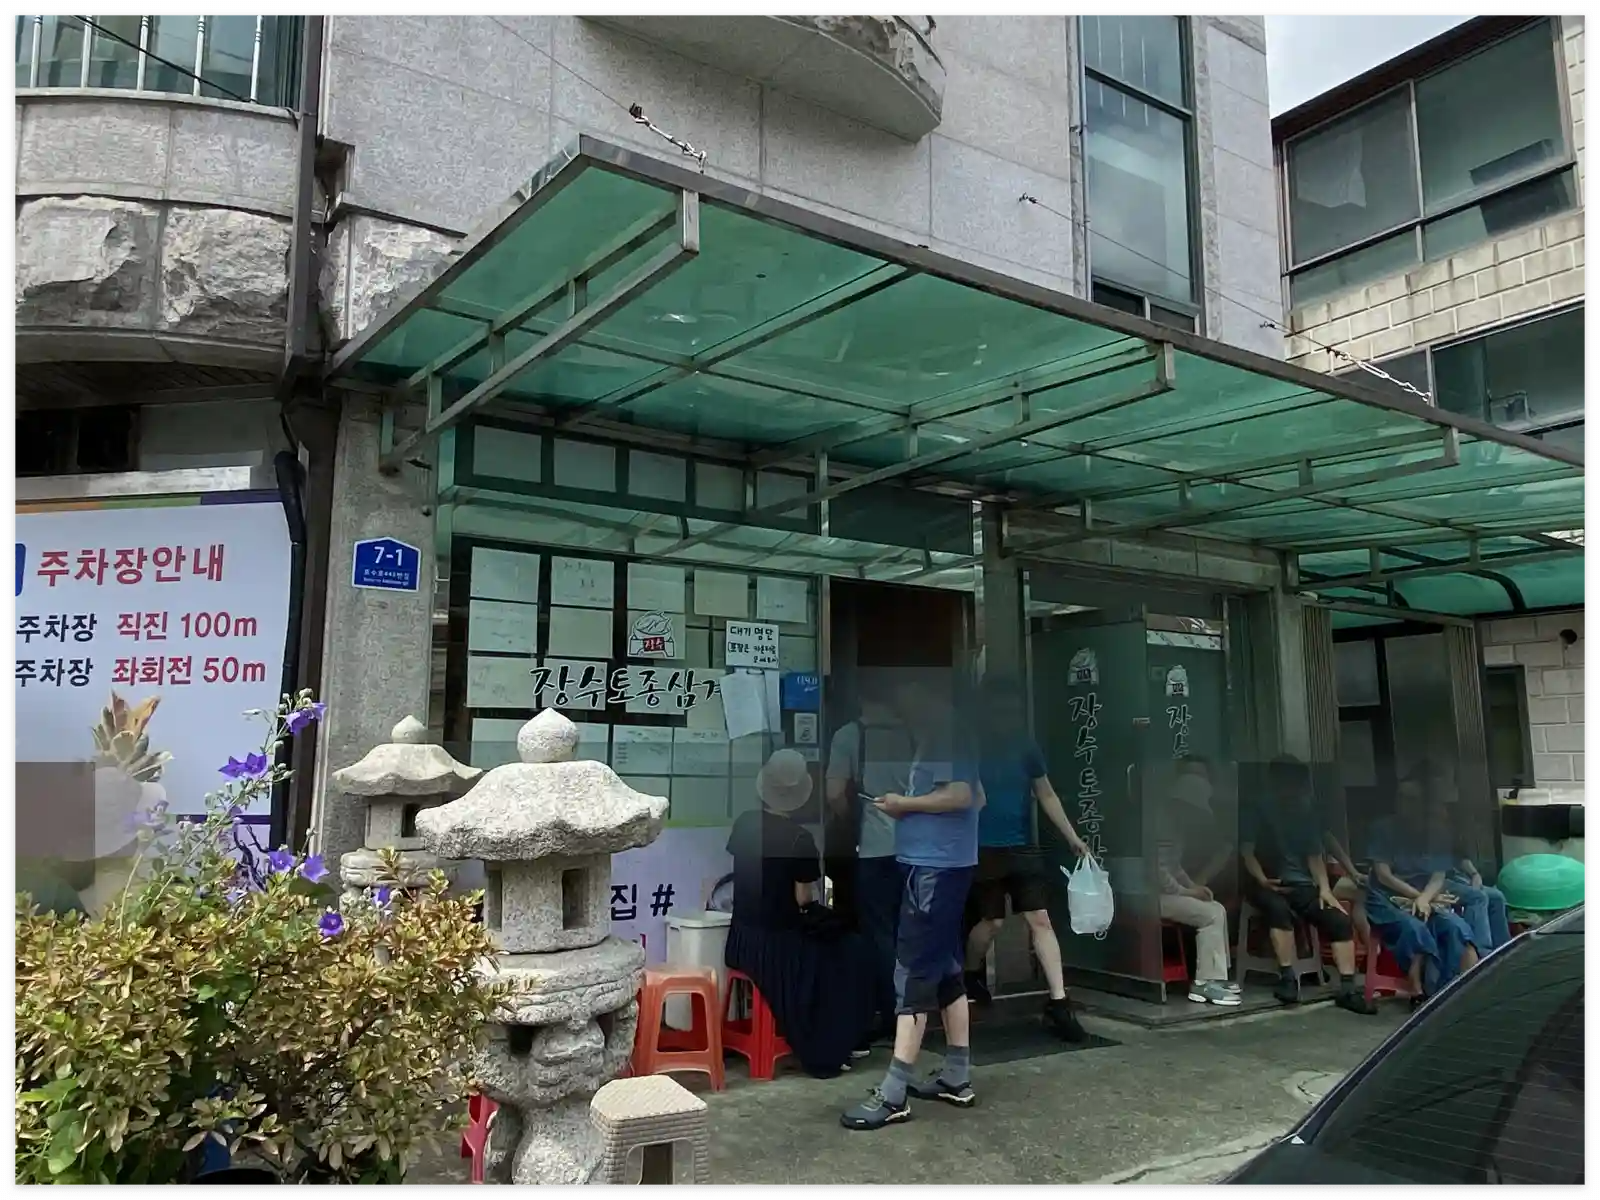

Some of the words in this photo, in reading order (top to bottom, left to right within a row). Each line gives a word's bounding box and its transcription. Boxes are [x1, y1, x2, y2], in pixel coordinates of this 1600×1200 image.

[37, 544, 224, 586] 주차장안내
[374, 546, 403, 566] 7-1
[16, 613, 98, 643] 주차장
[117, 611, 167, 641] 직진
[180, 612, 257, 638] 100m
[730, 626, 751, 637] 대기
[754, 627, 774, 641] 명단
[15, 657, 94, 687] 주차장
[112, 655, 192, 686] 좌회전
[203, 656, 266, 683] 50m
[611, 884, 638, 922] 집
[650, 883, 676, 918] #
